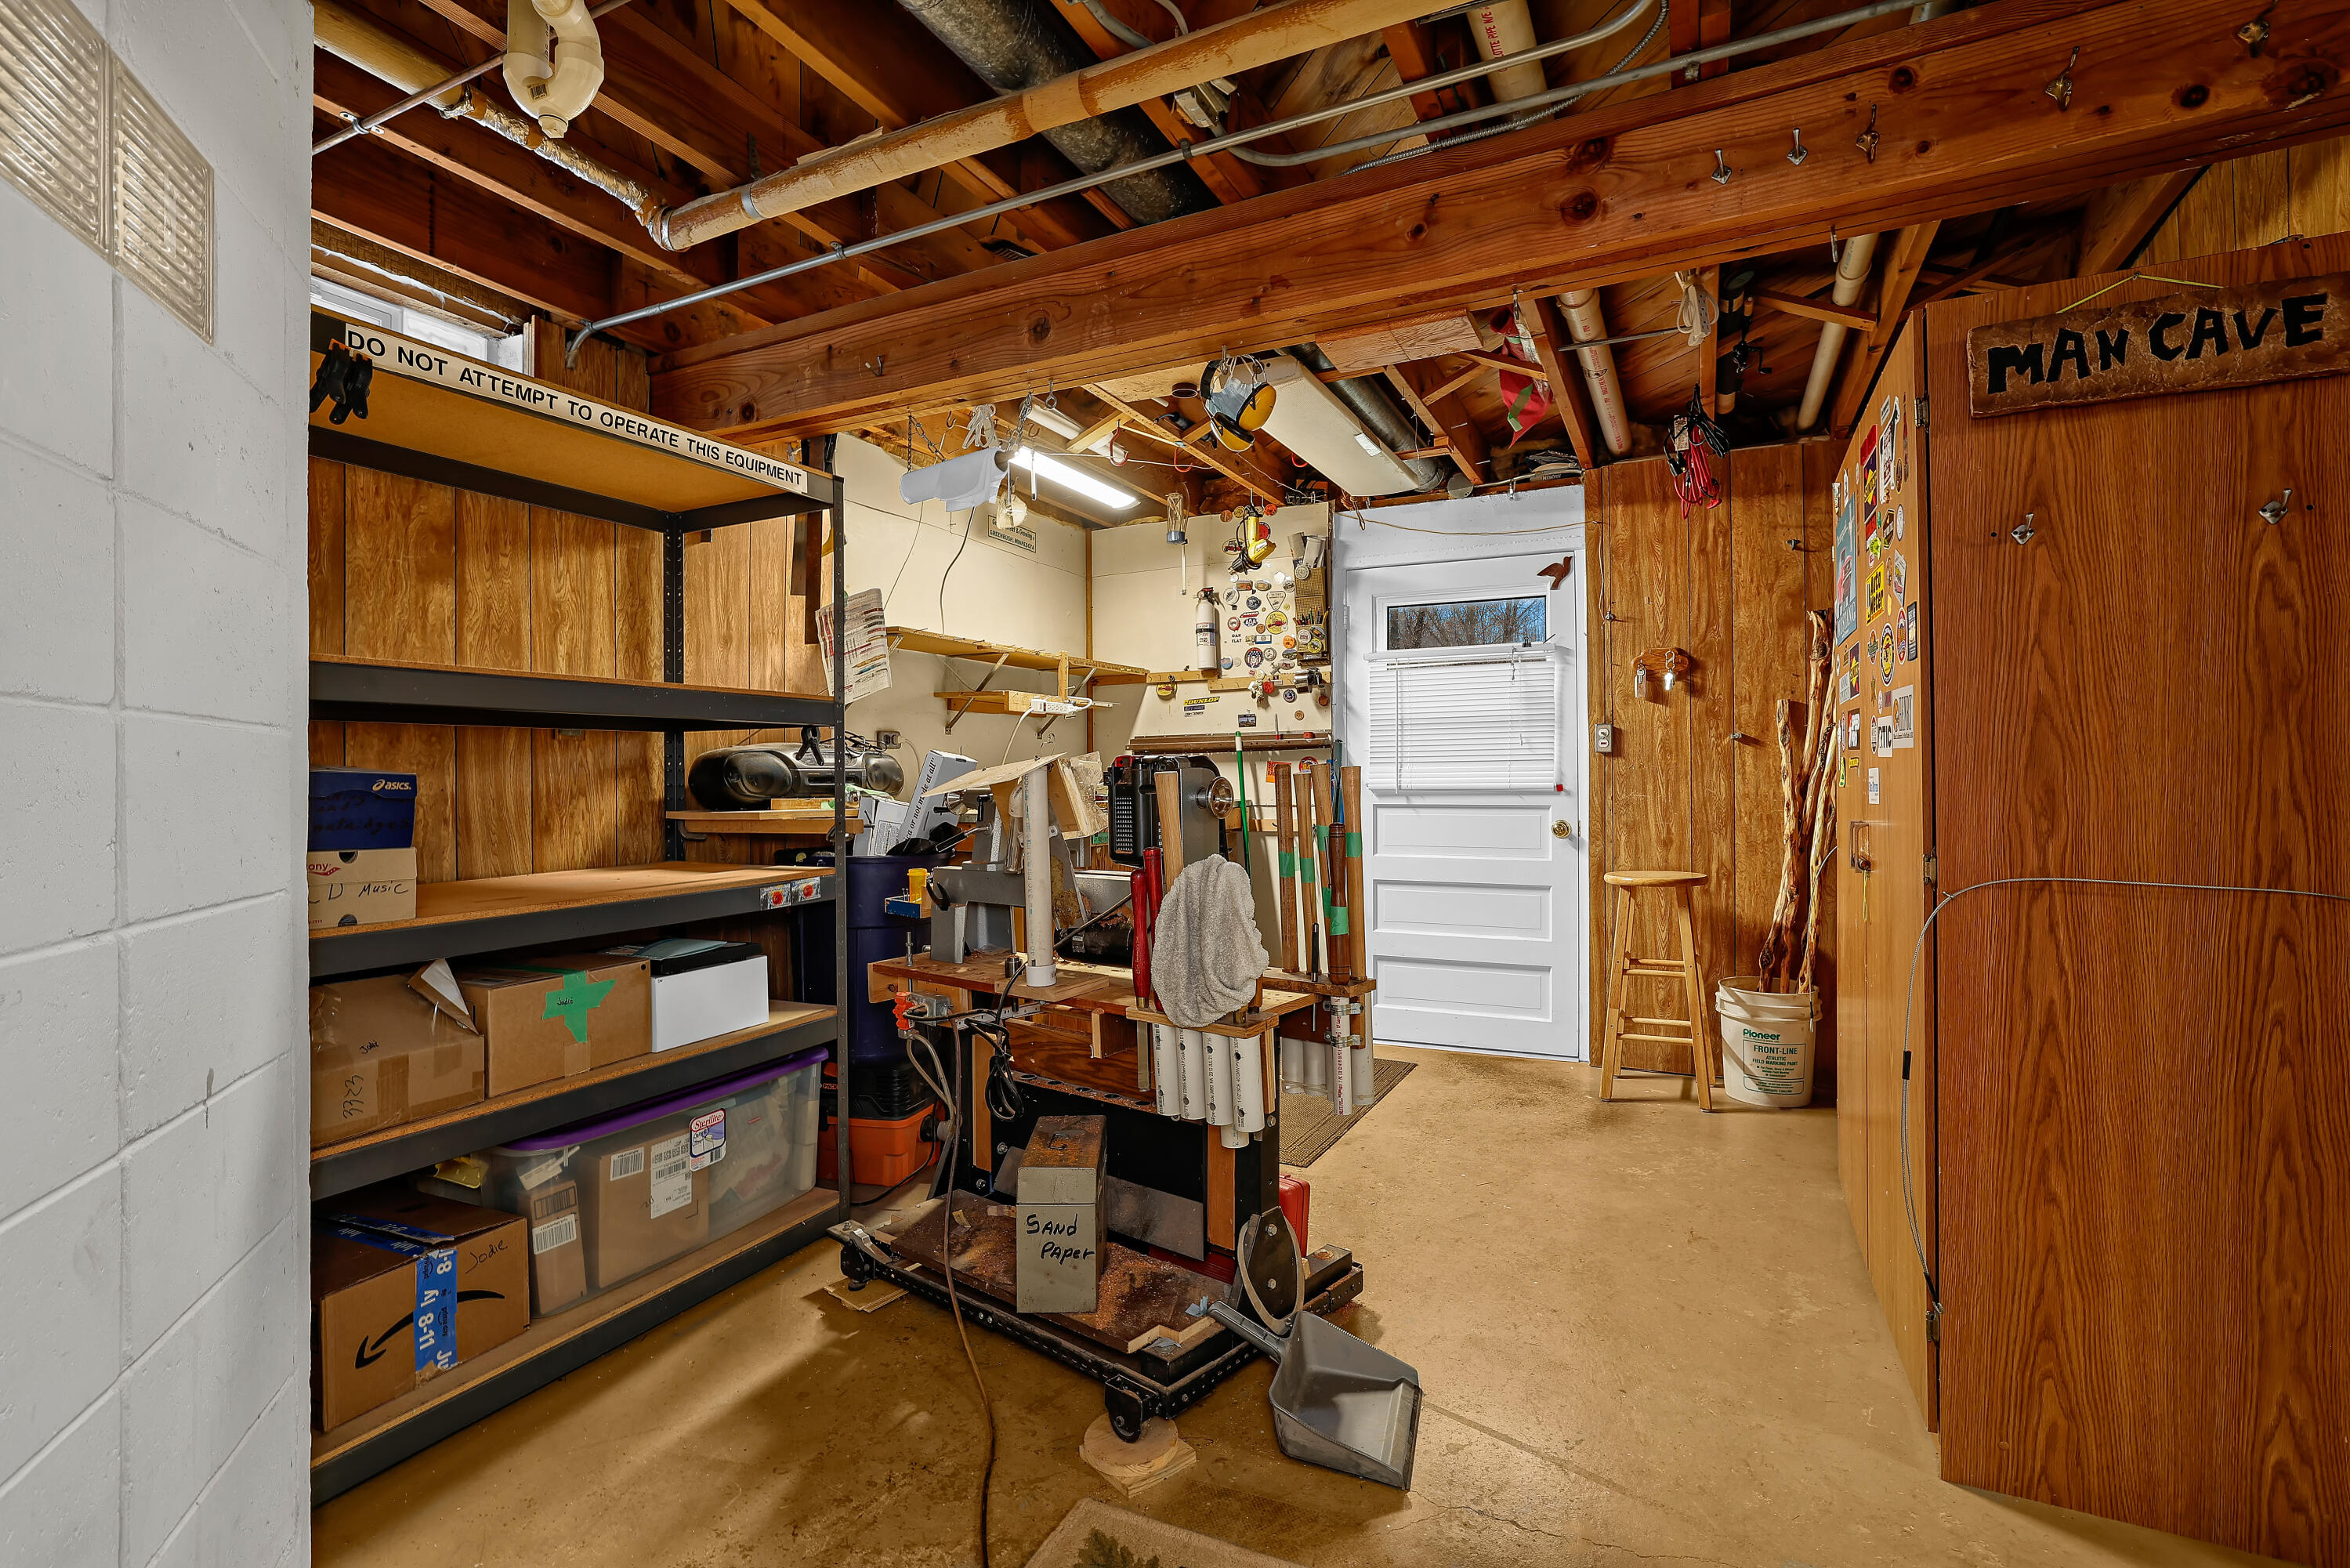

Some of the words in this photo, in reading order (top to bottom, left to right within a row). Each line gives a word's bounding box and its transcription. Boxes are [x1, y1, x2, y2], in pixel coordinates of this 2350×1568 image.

[1485, 25, 1498, 39] PIPE
[1987, 326, 2129, 395] MAN
[2148, 292, 2329, 362] CAVE
[347, 329, 386, 357] DO
[396, 346, 448, 377] NOT
[459, 368, 559, 411] ATTEMPT
[567, 399, 593, 422] TO
[599, 411, 679, 449] OPERATE
[686, 436, 721, 462] THIS
[726, 450, 802, 487] EQUIPMENT
[1188, 696, 1220, 704] DUNLOP
[1877, 725, 1892, 749] RTIC
[385, 781, 411, 791] asics
[913, 806, 922, 820] not
[918, 784, 929, 806] mde
[926, 774, 932, 784] at
[1753, 1045, 1798, 1055] FRONT-LINE
[694, 1114, 723, 1129] Sterilite
[465, 1240, 509, 1275] Jodie
[418, 1312, 436, 1351] 8-11
